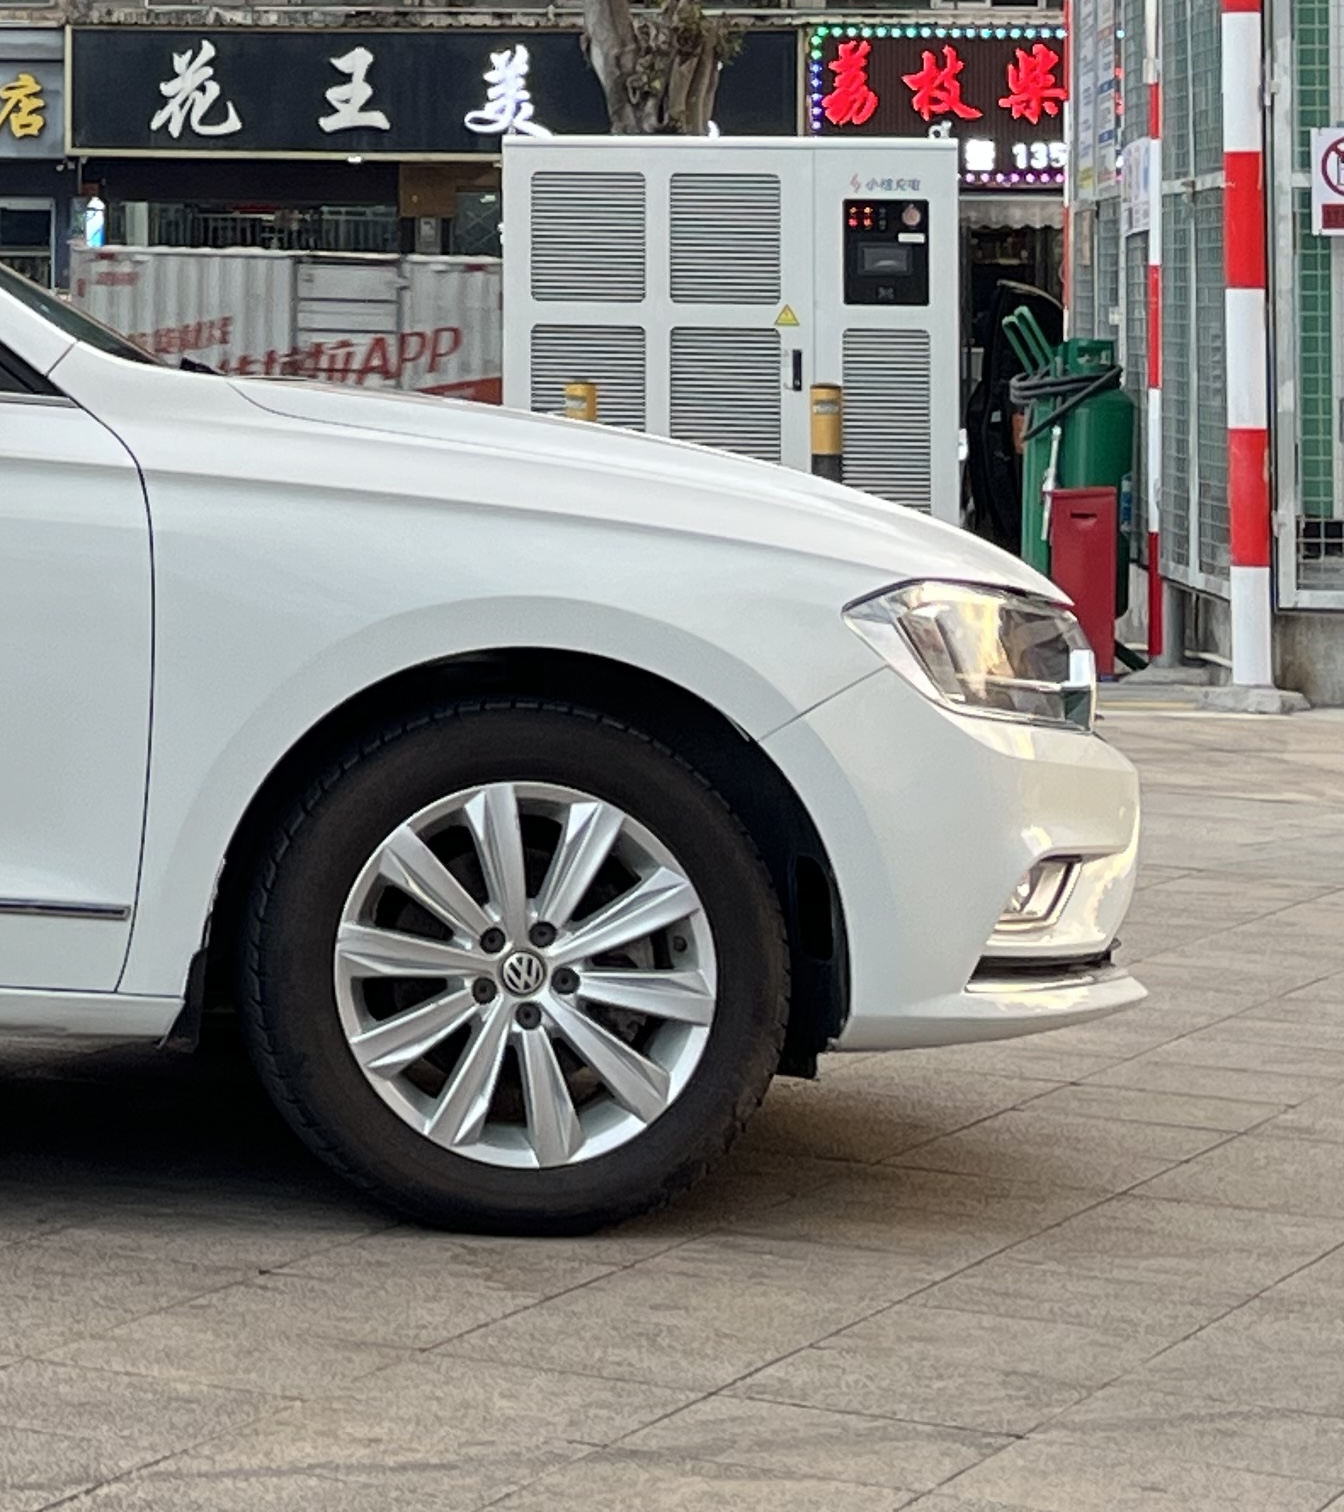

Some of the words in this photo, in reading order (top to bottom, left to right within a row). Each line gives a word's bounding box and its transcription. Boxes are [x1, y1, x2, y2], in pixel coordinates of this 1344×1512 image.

[150, 39, 553, 138] 花王美
[821, 40, 1068, 125] 荔枝柴
